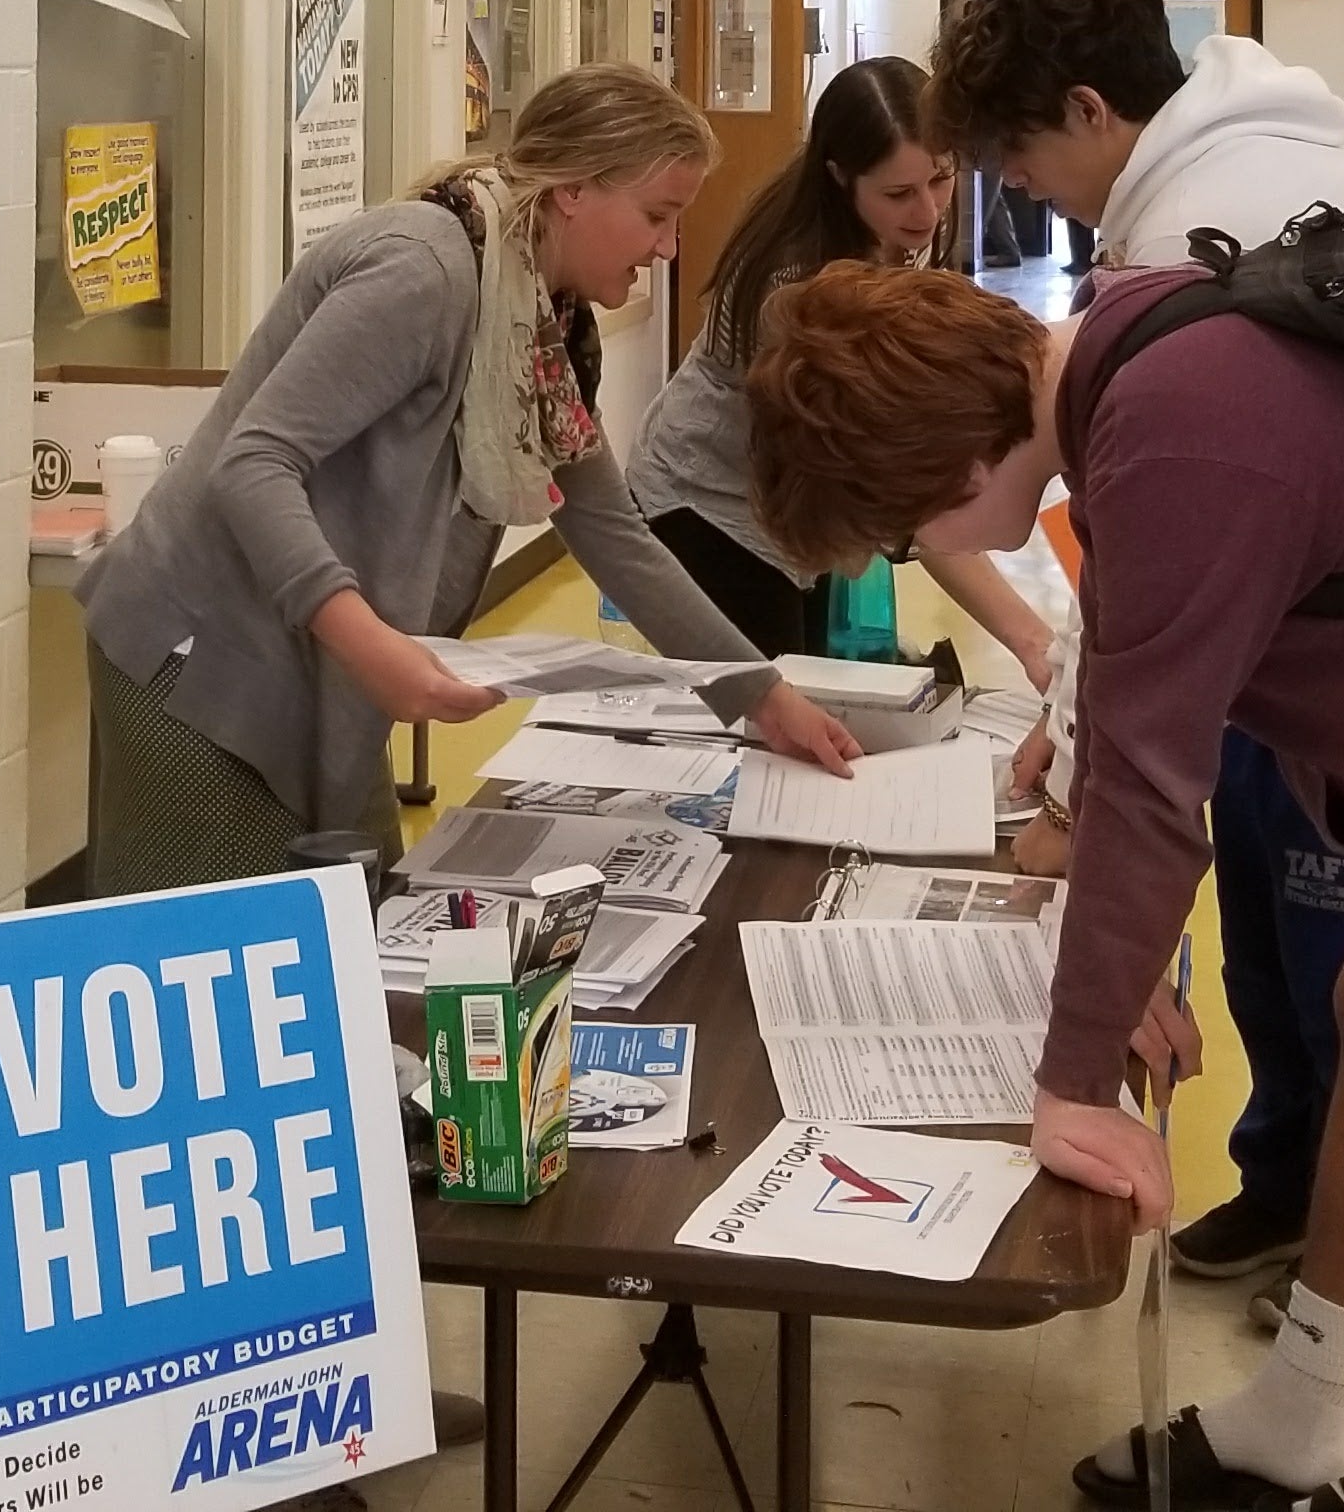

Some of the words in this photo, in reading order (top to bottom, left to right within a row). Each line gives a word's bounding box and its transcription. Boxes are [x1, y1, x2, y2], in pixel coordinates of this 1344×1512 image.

[341, 39, 359, 69] NEW
[333, 78, 341, 104] to
[342, 74, 359, 103] CPS!
[72, 181, 148, 248] RESPECT
[538, 912, 559, 935] 50
[553, 936, 577, 953] BIC
[517, 1007, 530, 1031] 50
[441, 1123, 458, 1169] BIC
[541, 1154, 558, 1177] BIC
[709, 1218, 745, 1244] DID
[728, 1196, 771, 1220] YOU
[750, 1168, 793, 1199] VOTE
[775, 1125, 831, 1168] TODAY?
[9, 1108, 346, 1334] HERE
[234, 1312, 355, 1362] BUDGET
[194, 1375, 294, 1421] ALDERMAN
[297, 1362, 343, 1392] JOHN
[170, 1372, 374, 1494] ARENA
[348, 1443, 361, 1457] 45
[5, 1440, 82, 1479] Decide
[25, 1481, 69, 1511] Will
[77, 1471, 105, 1495] be
